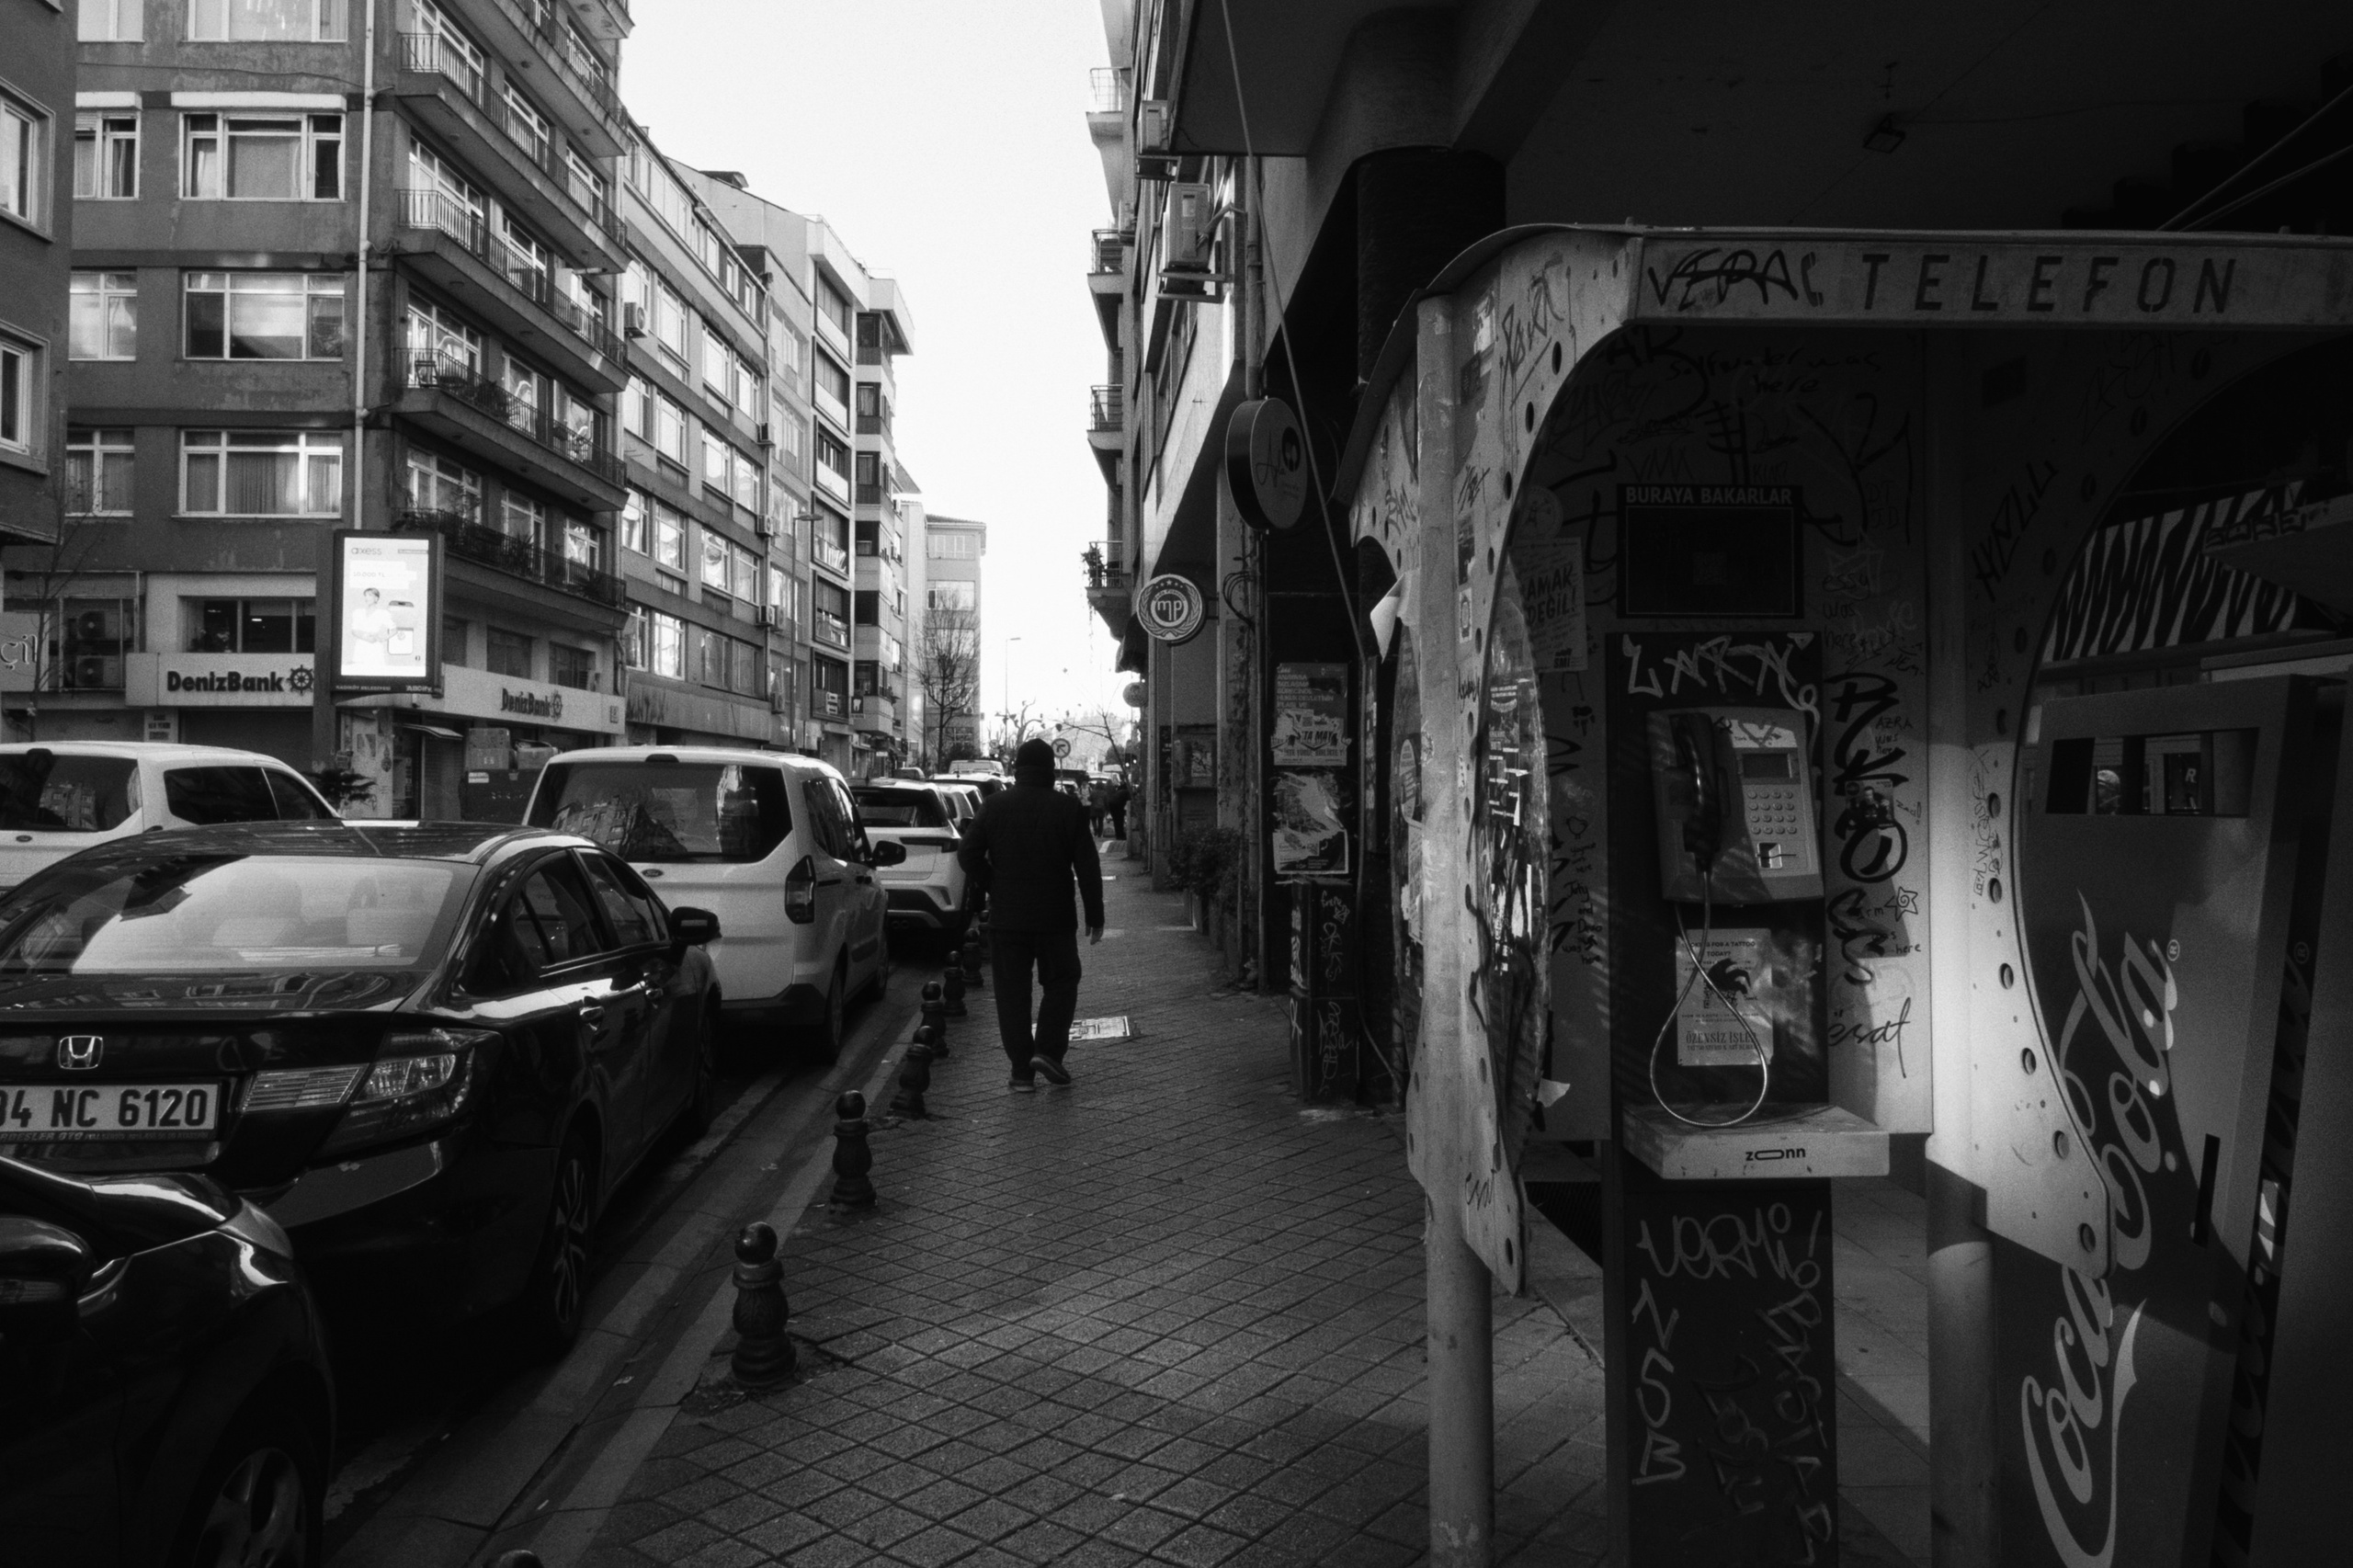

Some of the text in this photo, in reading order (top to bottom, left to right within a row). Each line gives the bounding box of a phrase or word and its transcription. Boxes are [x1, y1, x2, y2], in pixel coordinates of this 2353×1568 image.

[1862, 253, 2236, 313] TELEFON
[1625, 487, 1793, 505] BURAYA BAKARLAR
[1157, 600, 1182, 621] mp
[167, 671, 283, 691] DenizBank
[502, 688, 551, 716] DenizBank
[51, 1089, 99, 1128] NC
[119, 1088, 208, 1128] 6120
